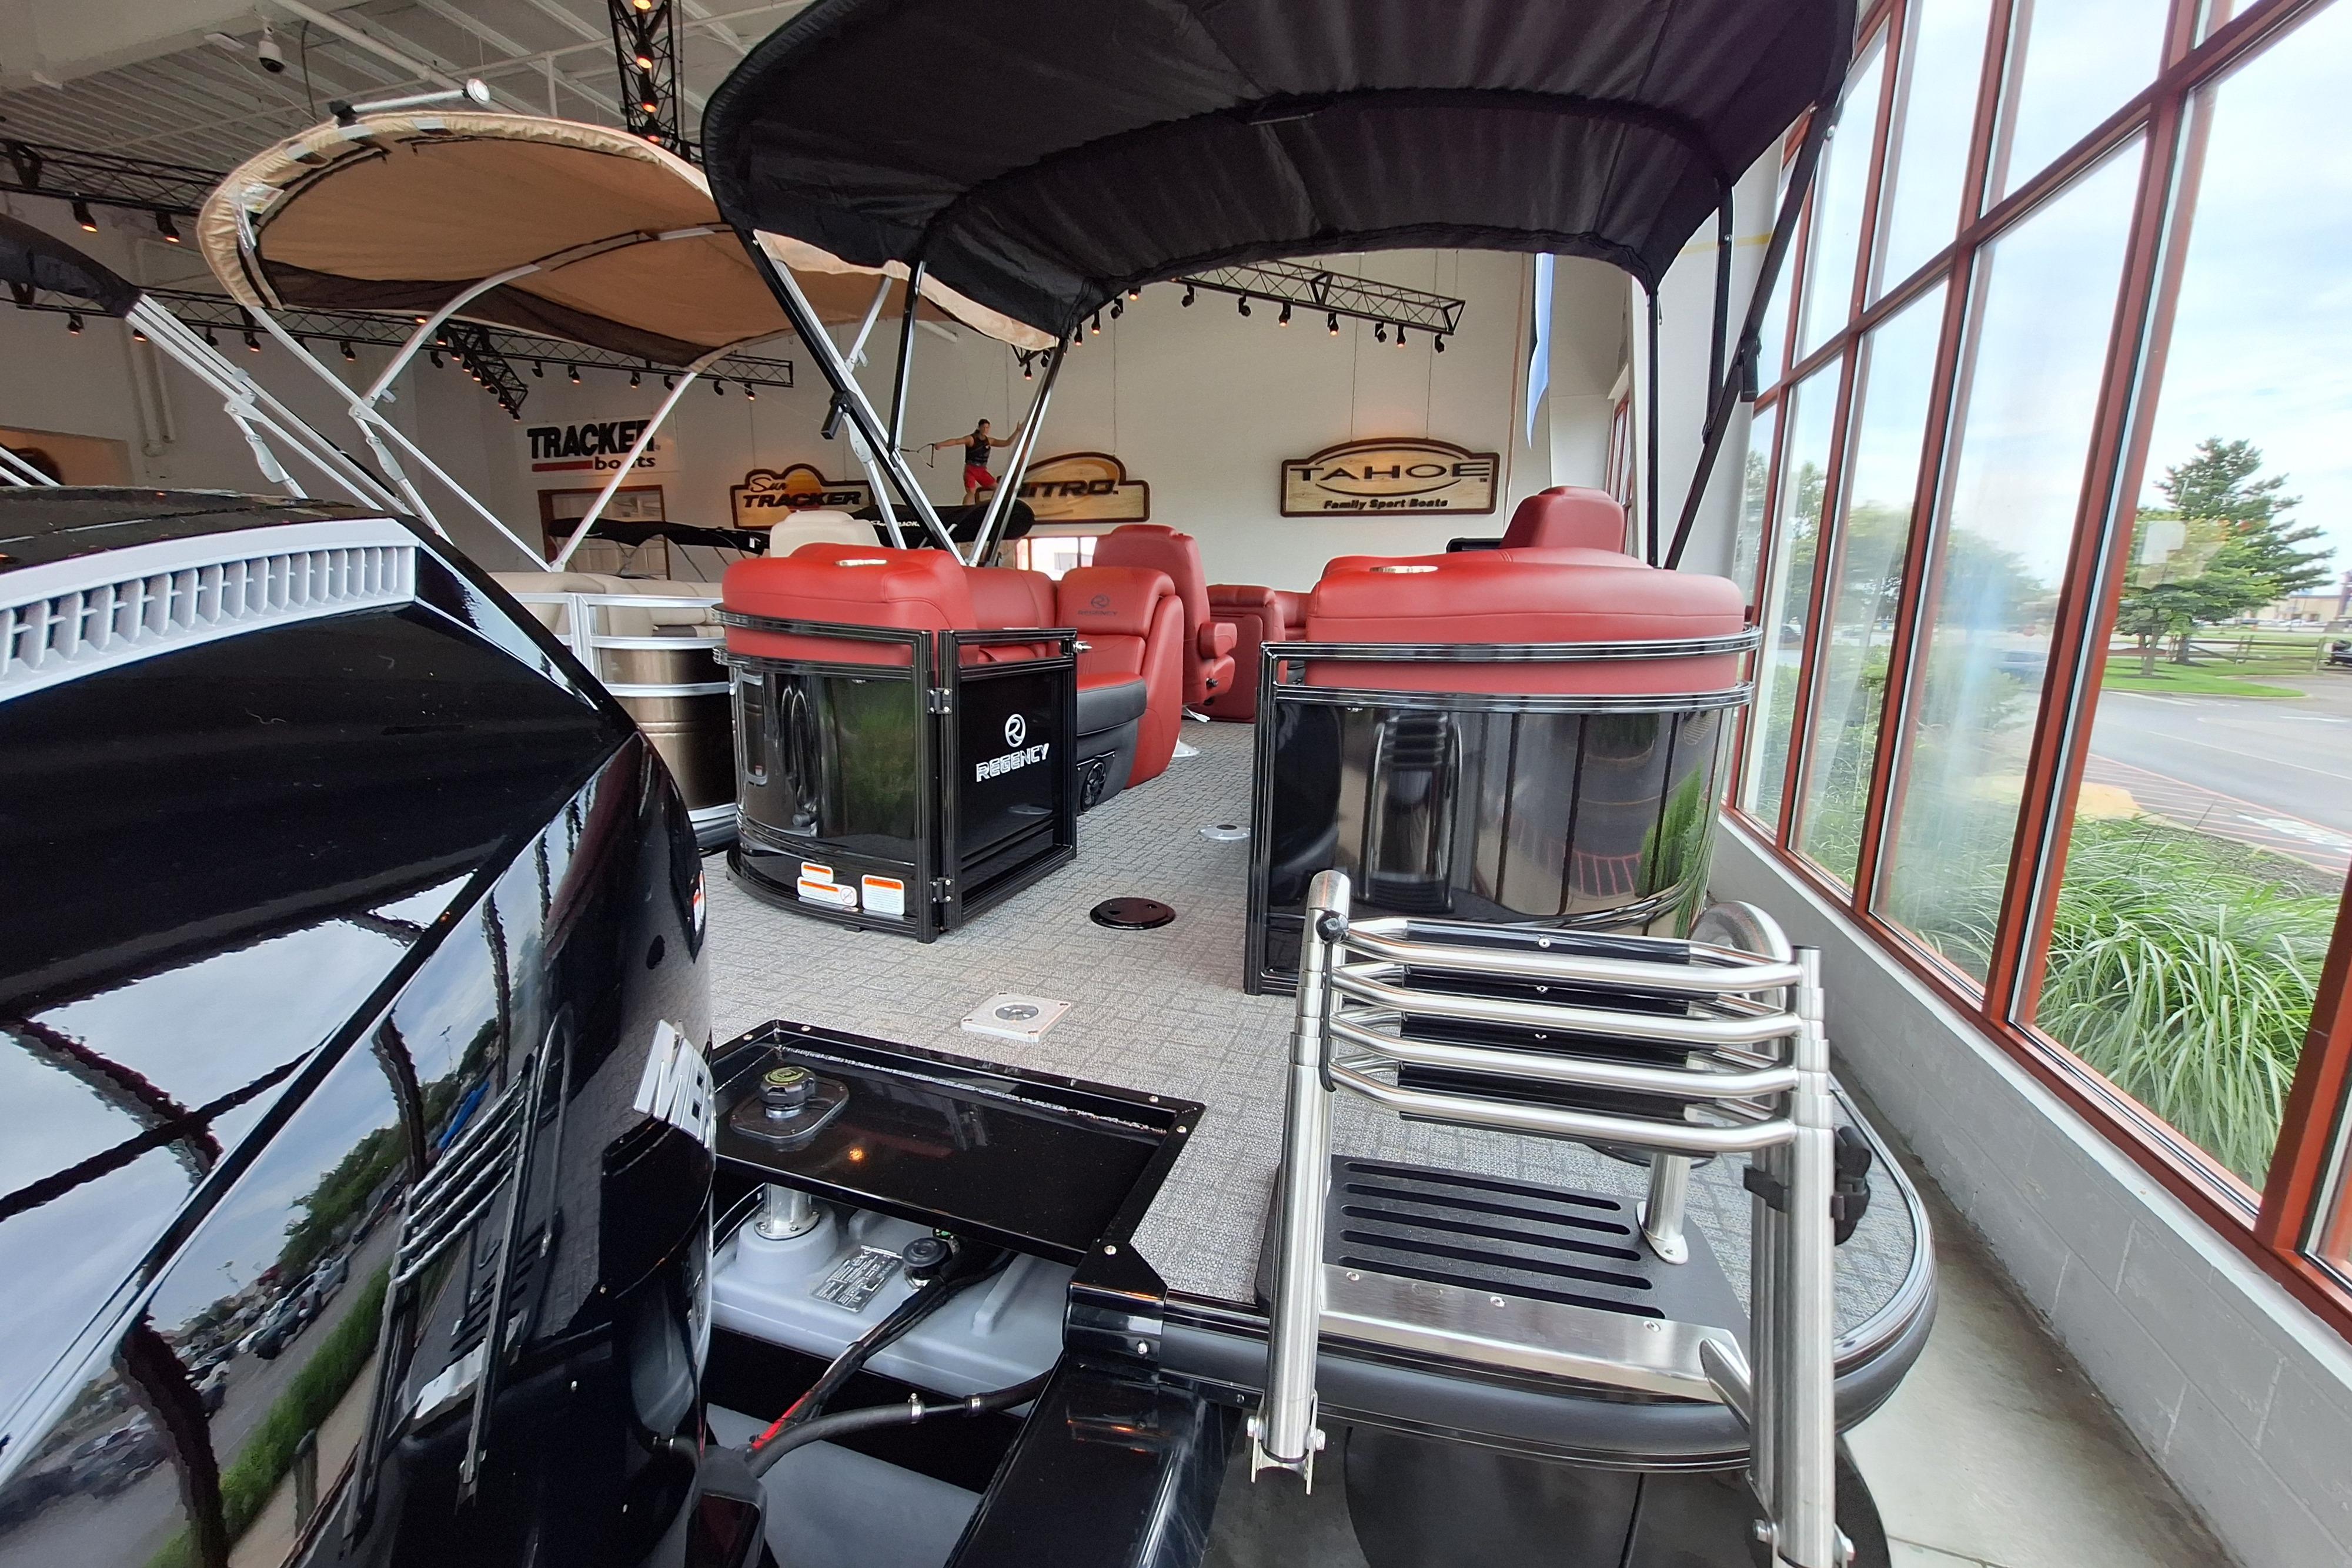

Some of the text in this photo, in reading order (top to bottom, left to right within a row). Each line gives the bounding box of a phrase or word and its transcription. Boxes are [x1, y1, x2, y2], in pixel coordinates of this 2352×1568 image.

[595, 456, 656, 470] bots
[1289, 462, 1490, 481] TAHOE
[750, 477, 789, 493] Sun
[743, 491, 861, 508] TRACKER
[1324, 499, 1449, 510] Family Sport Boats
[976, 743, 1050, 783] REGENCY
